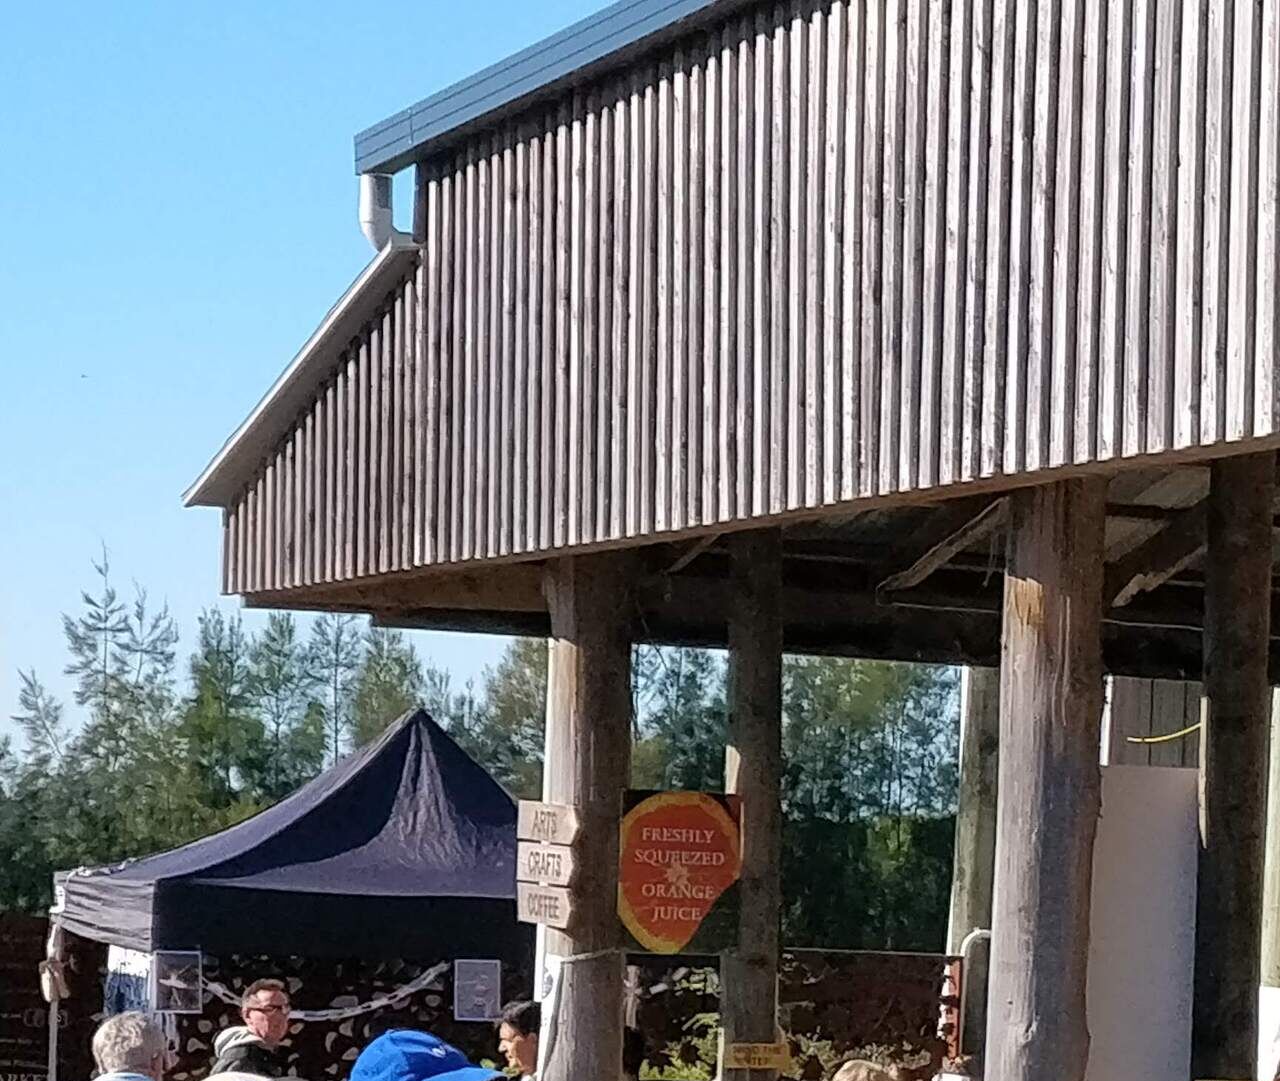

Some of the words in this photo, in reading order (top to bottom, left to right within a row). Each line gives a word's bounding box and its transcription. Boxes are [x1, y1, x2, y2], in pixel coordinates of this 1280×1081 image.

[533, 810, 558, 839] ARTS
[642, 827, 715, 844] FRESHLY
[527, 850, 562, 878] CRAFTS
[634, 850, 725, 866] SQUEEZED
[641, 884, 715, 899] ORANGE
[527, 892, 560, 919] COFFEE
[651, 906, 703, 922] JUICE
